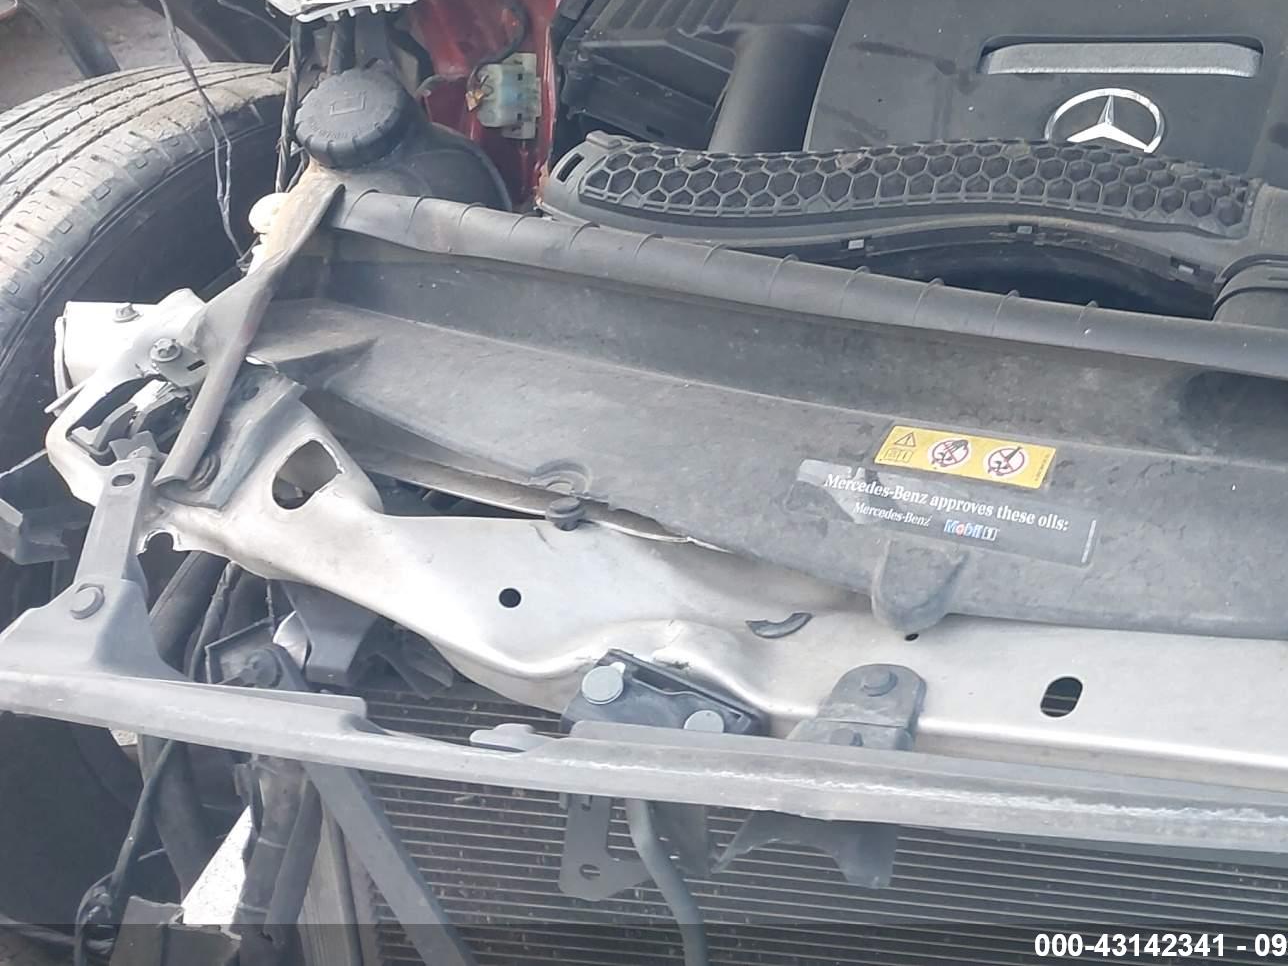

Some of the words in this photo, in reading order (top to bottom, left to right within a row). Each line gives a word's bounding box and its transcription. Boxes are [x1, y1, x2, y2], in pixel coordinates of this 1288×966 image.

[823, 473, 928, 504] Mercedes-Benz
[929, 494, 994, 516] approves
[996, 505, 1036, 525] these
[1038, 513, 1070, 532] oils:
[853, 501, 933, 527] Mercedes-Benz
